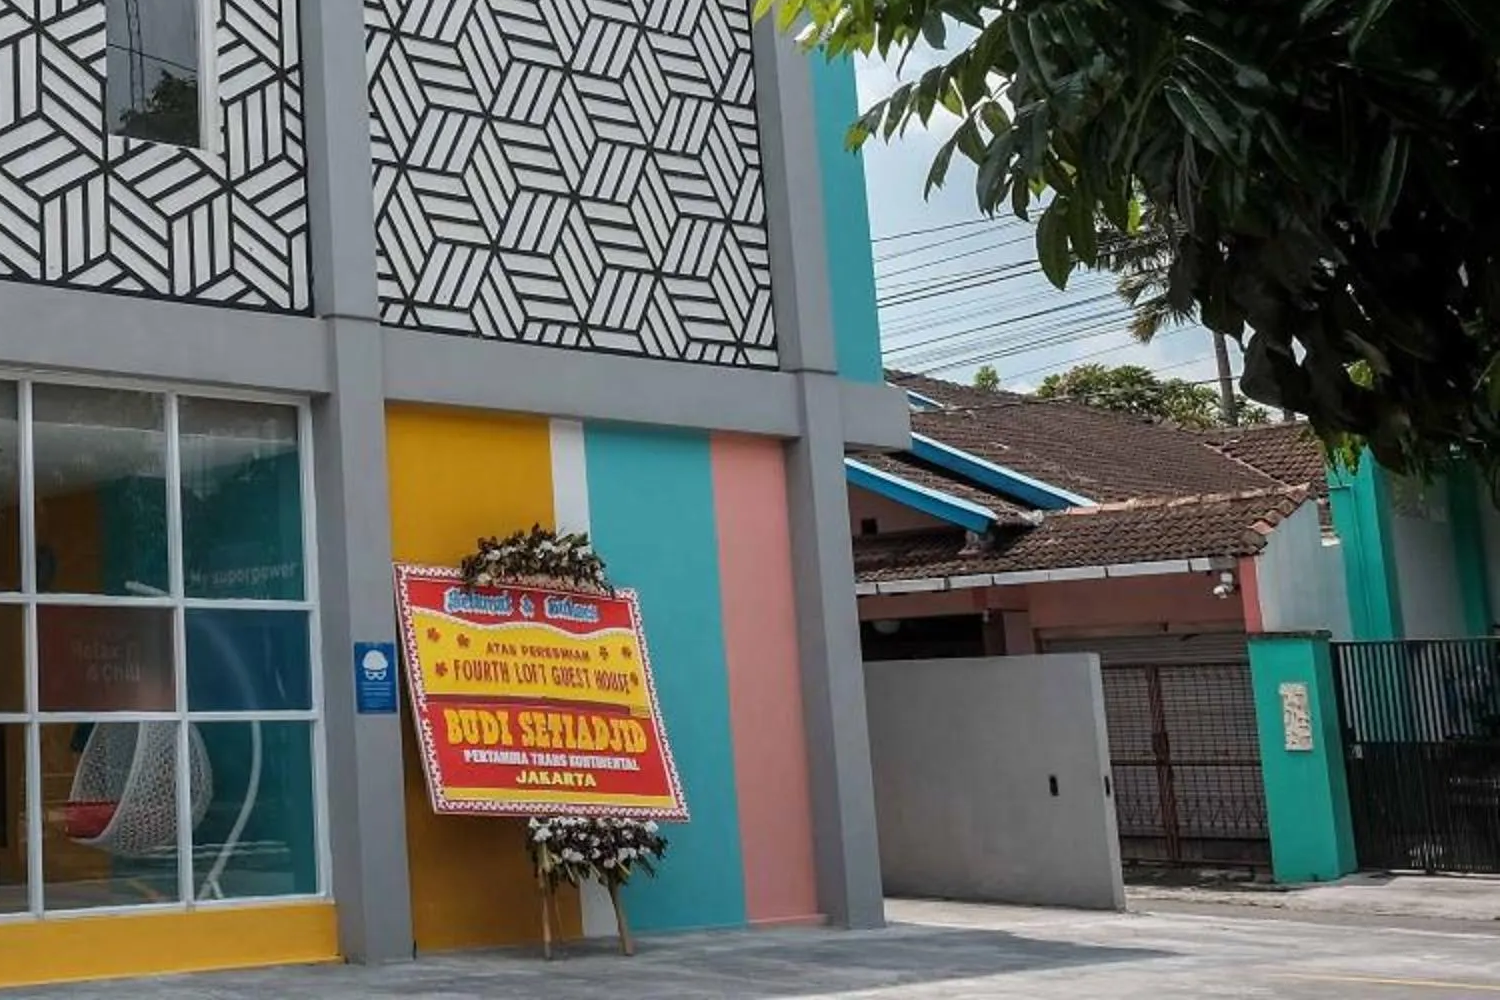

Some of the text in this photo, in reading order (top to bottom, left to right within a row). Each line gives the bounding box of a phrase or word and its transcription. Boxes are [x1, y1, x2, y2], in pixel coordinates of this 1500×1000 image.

[453, 659, 630, 695] FOURTH LOFT GUEST HOUSE
[443, 707, 514, 746] BUDI
[531, 752, 567, 767] TRANS
[516, 770, 597, 787] JAKARTA
